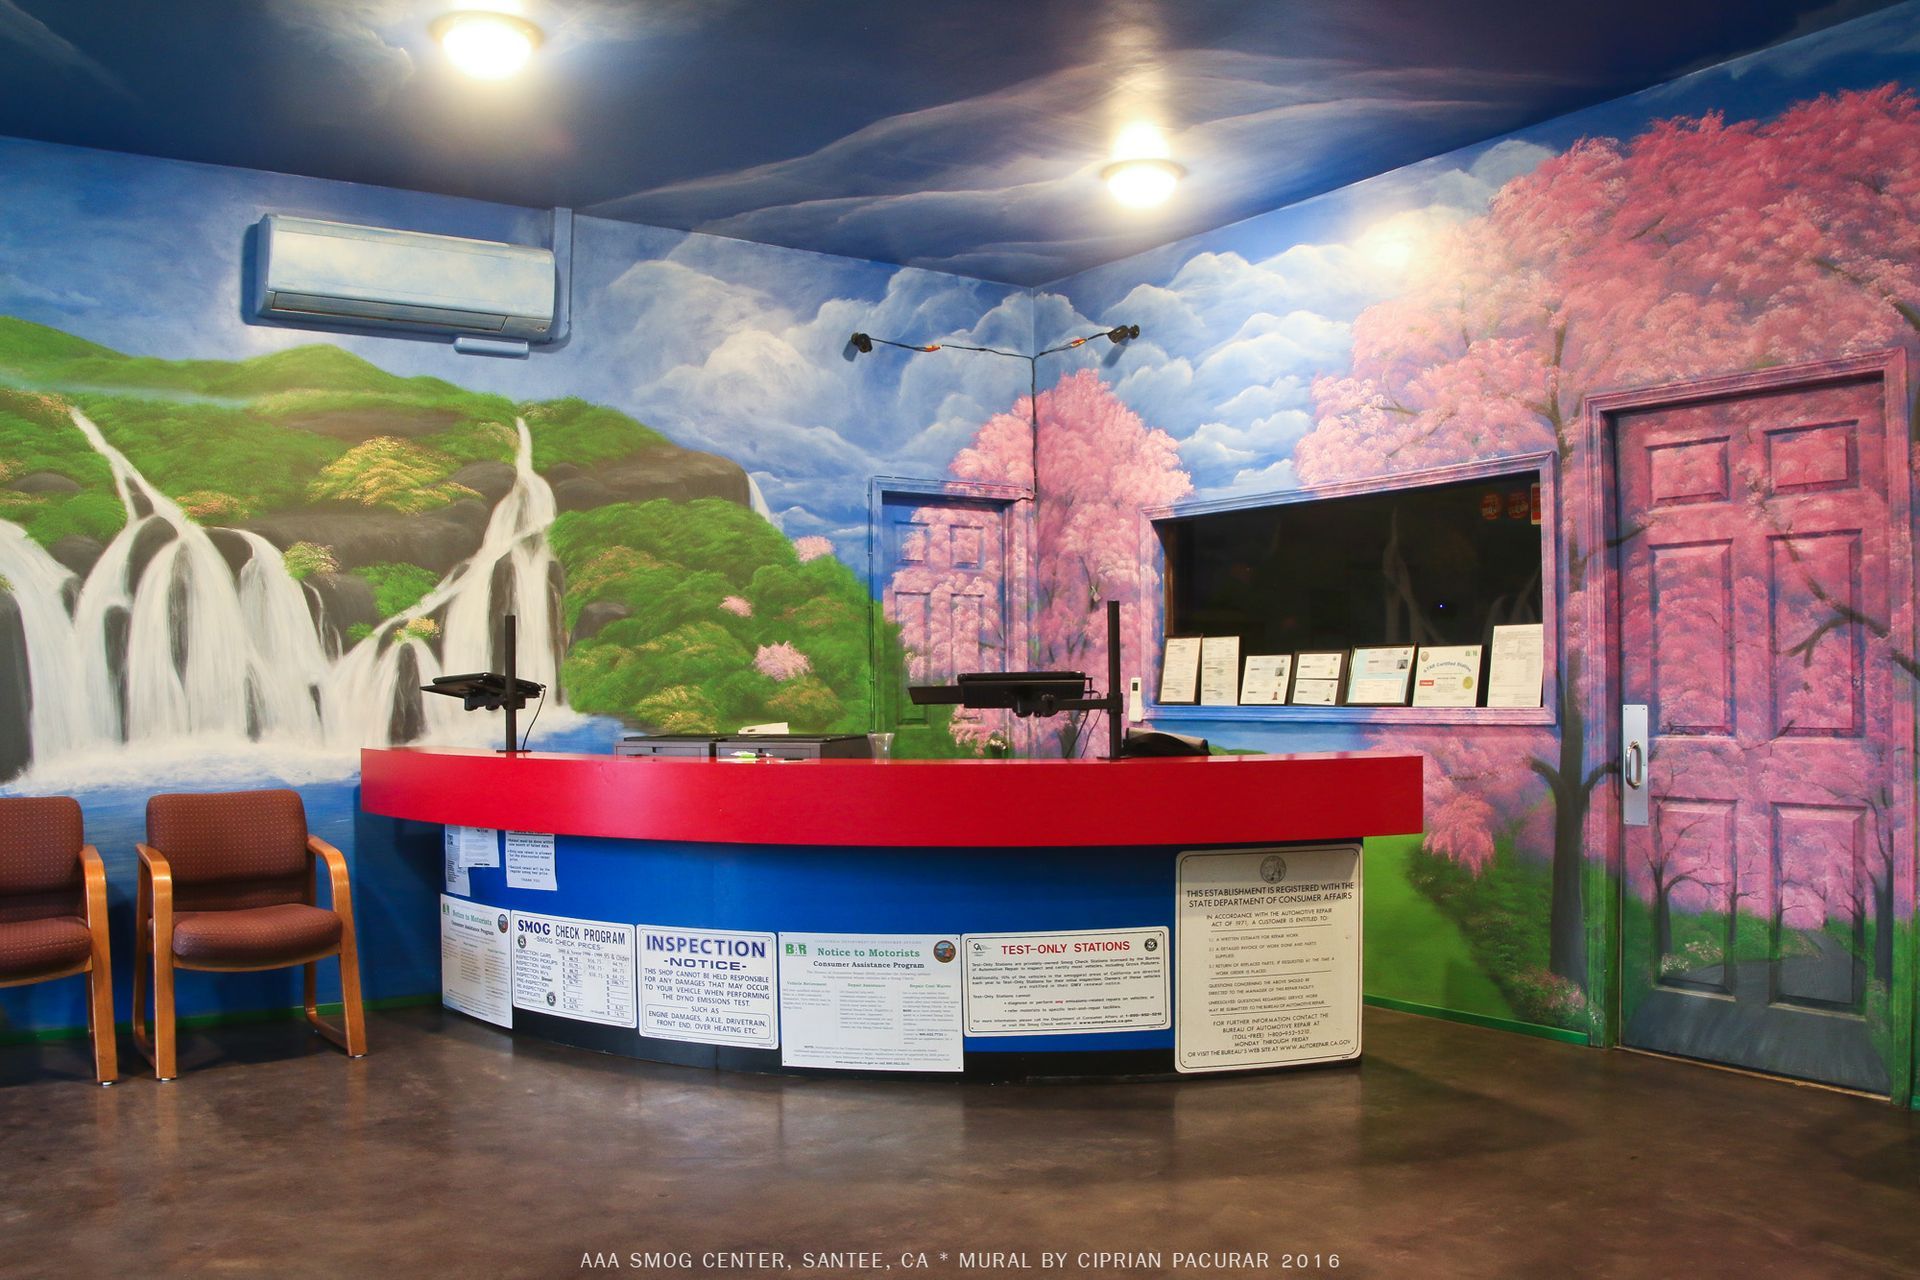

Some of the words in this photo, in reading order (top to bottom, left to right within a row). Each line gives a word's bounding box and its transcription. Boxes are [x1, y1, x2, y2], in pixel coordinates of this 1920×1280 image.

[1187, 889, 1203, 897] THIS
[1204, 886, 1267, 896] ESTABLISHMENT
[1276, 883, 1319, 893] REGISTERED
[1321, 882, 1340, 891] WITH
[1189, 899, 1212, 907] STATE
[1214, 896, 1264, 906] DEPARTMENT
[1278, 893, 1321, 903] CONSUMER
[1324, 892, 1352, 900] AFFAIRS
[518, 920, 550, 935] SMOG
[556, 925, 580, 940] CHECK
[584, 928, 625, 944] PROGRAM
[646, 935, 765, 957] INSPECTION
[818, 948, 850, 956] Notice
[869, 949, 920, 957] Motorists
[1001, 942, 1067, 955] TEST-ONLY
[1074, 940, 1130, 953] STATIONS
[676, 970, 700, 978] CANNOT
[730, 974, 769, 983] RESPONSIBLE
[675, 978, 705, 986] DAMAGES
[746, 983, 769, 991] OCCUR
[676, 986, 701, 994] VEHICLE
[727, 990, 770, 1000] PERFORMING
[676, 994, 694, 1002] DYNO
[697, 996, 730, 1005] EMISSIONS
[648, 1010, 668, 1018] ENGINE
[714, 1024, 741, 1033] HEATING
